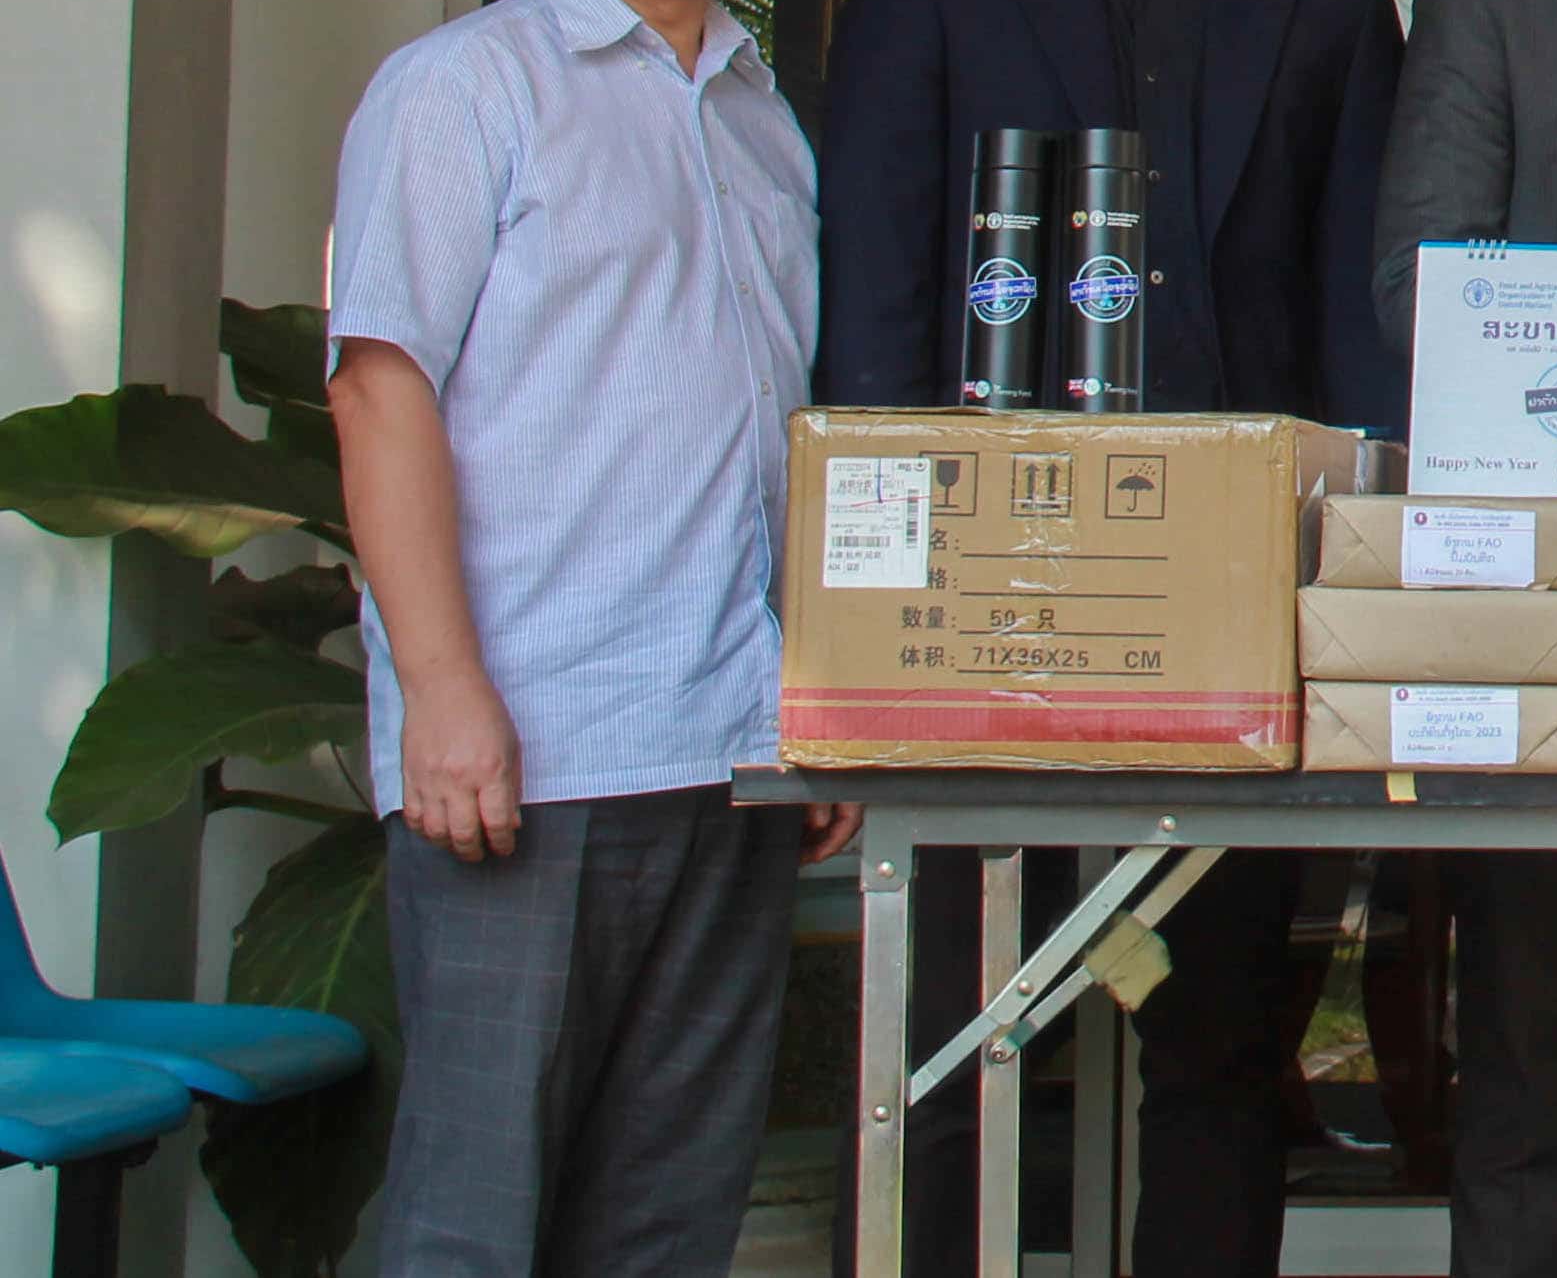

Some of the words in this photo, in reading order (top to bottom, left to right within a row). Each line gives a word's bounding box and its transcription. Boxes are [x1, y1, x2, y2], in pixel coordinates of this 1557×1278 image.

[1426, 455, 1471, 472] Happy
[1475, 457, 1505, 469] New
[1508, 458, 1539, 470] Year
[1478, 537, 1503, 548] FAO
[989, 609, 1016, 628] 50
[1124, 650, 1162, 669] CM
[1459, 712, 1485, 722] FAO
[1475, 726, 1503, 738] 2023
